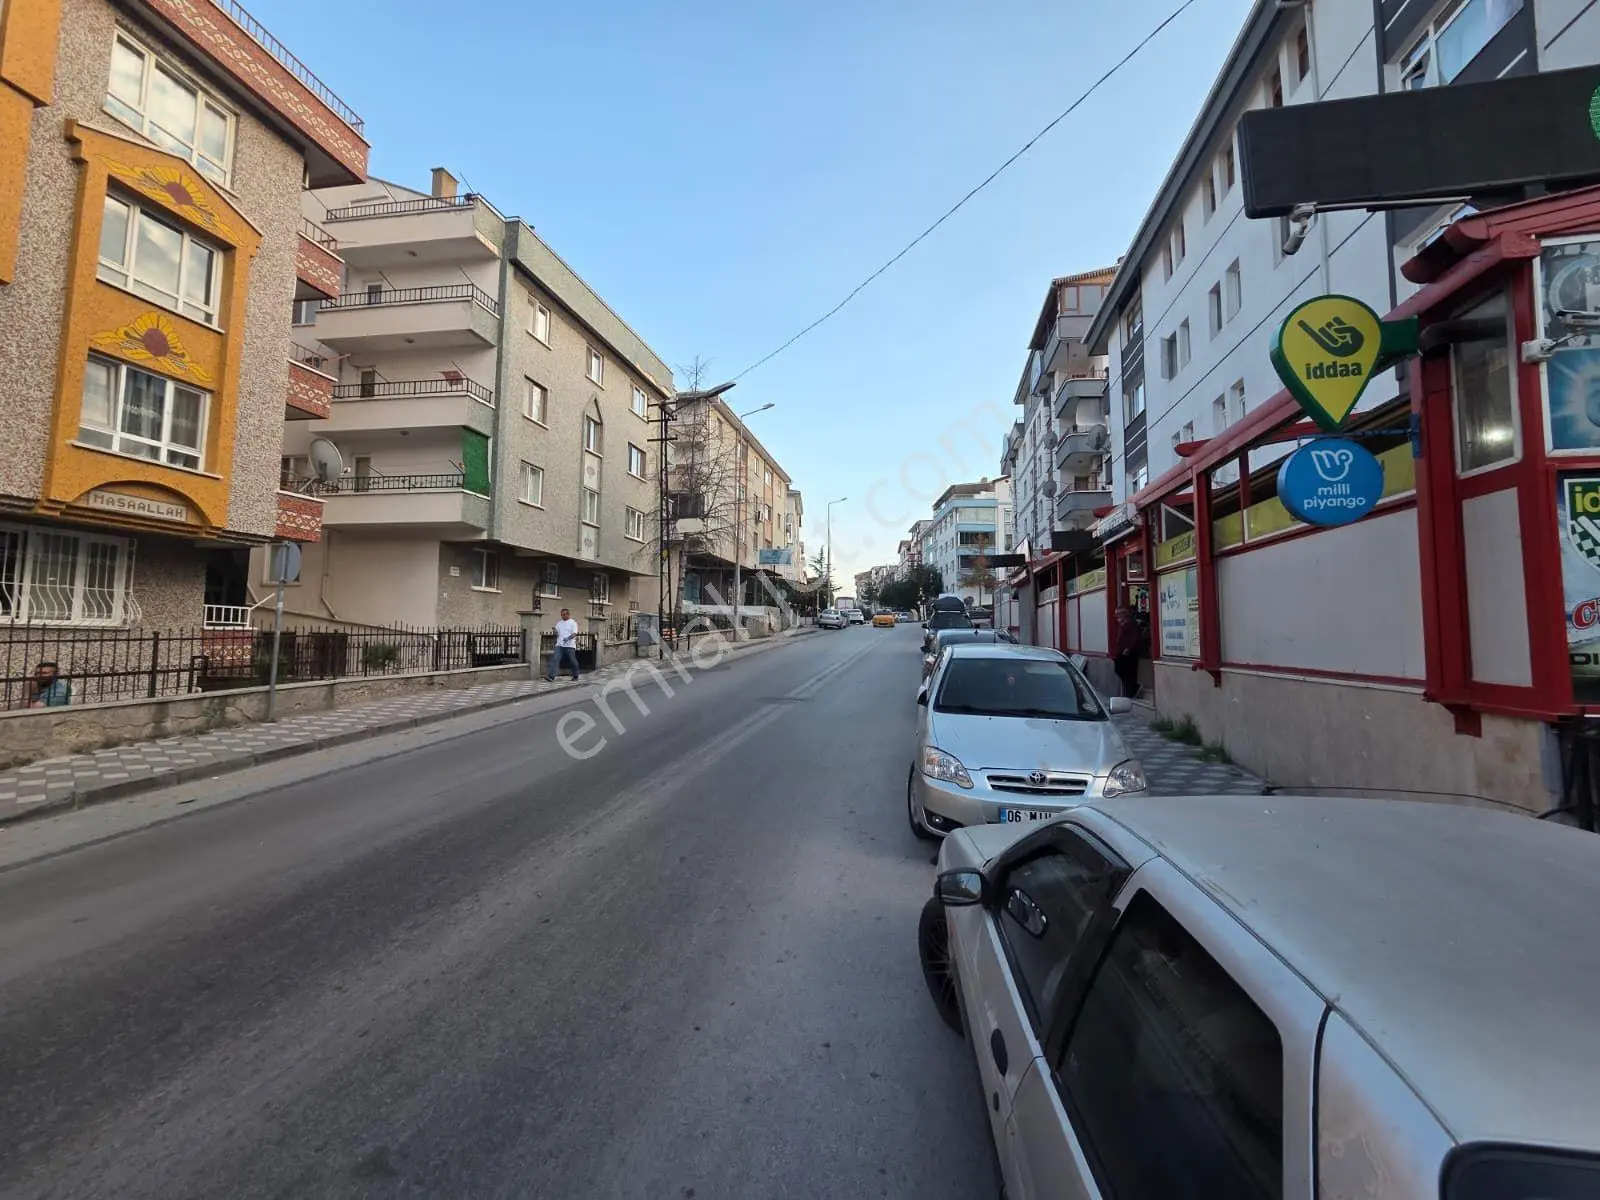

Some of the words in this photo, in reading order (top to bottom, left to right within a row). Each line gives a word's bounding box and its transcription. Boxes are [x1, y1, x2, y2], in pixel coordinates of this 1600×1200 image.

[1305, 361, 1363, 380] iddaa
[1318, 484, 1351, 496] milli
[1303, 496, 1367, 510] piyango
[1007, 810, 1021, 823] 06
